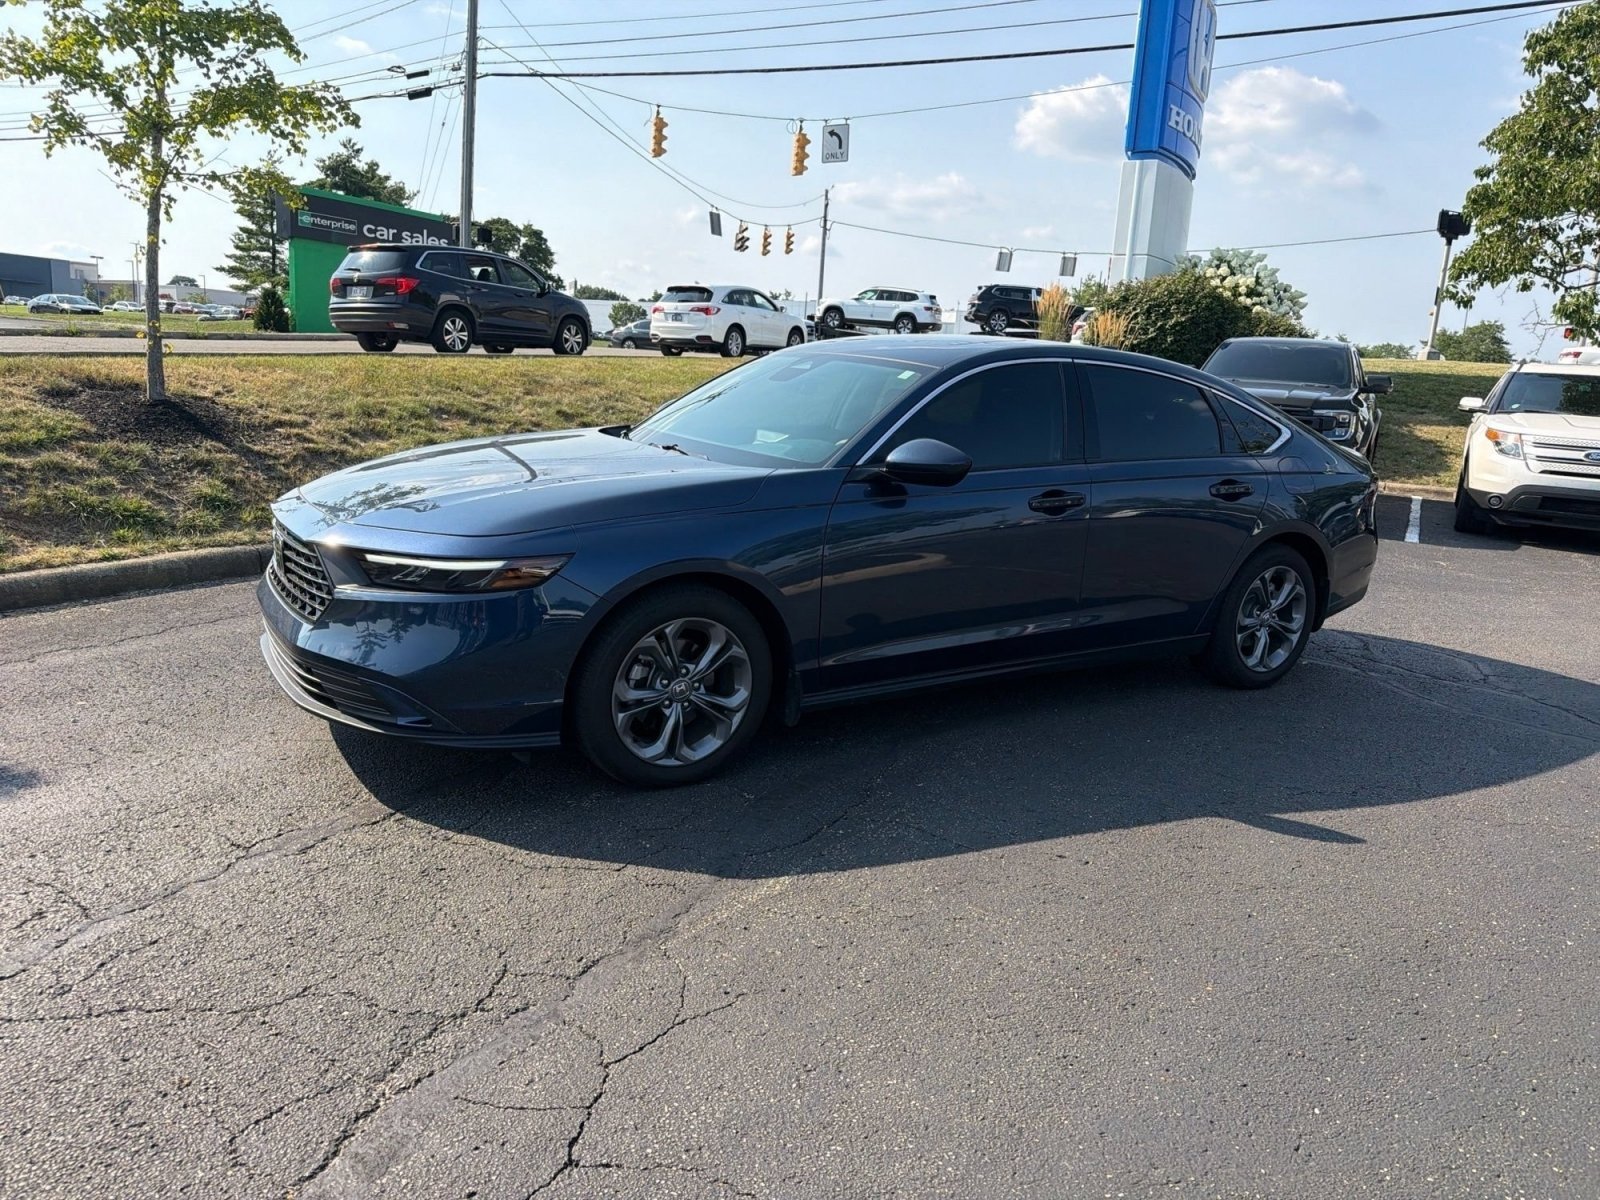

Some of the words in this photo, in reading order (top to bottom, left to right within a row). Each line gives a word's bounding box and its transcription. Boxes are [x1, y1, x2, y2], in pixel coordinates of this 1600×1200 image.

[825, 151, 845, 160] ONLY
[301, 215, 356, 231] enterprise
[362, 224, 397, 241] car
